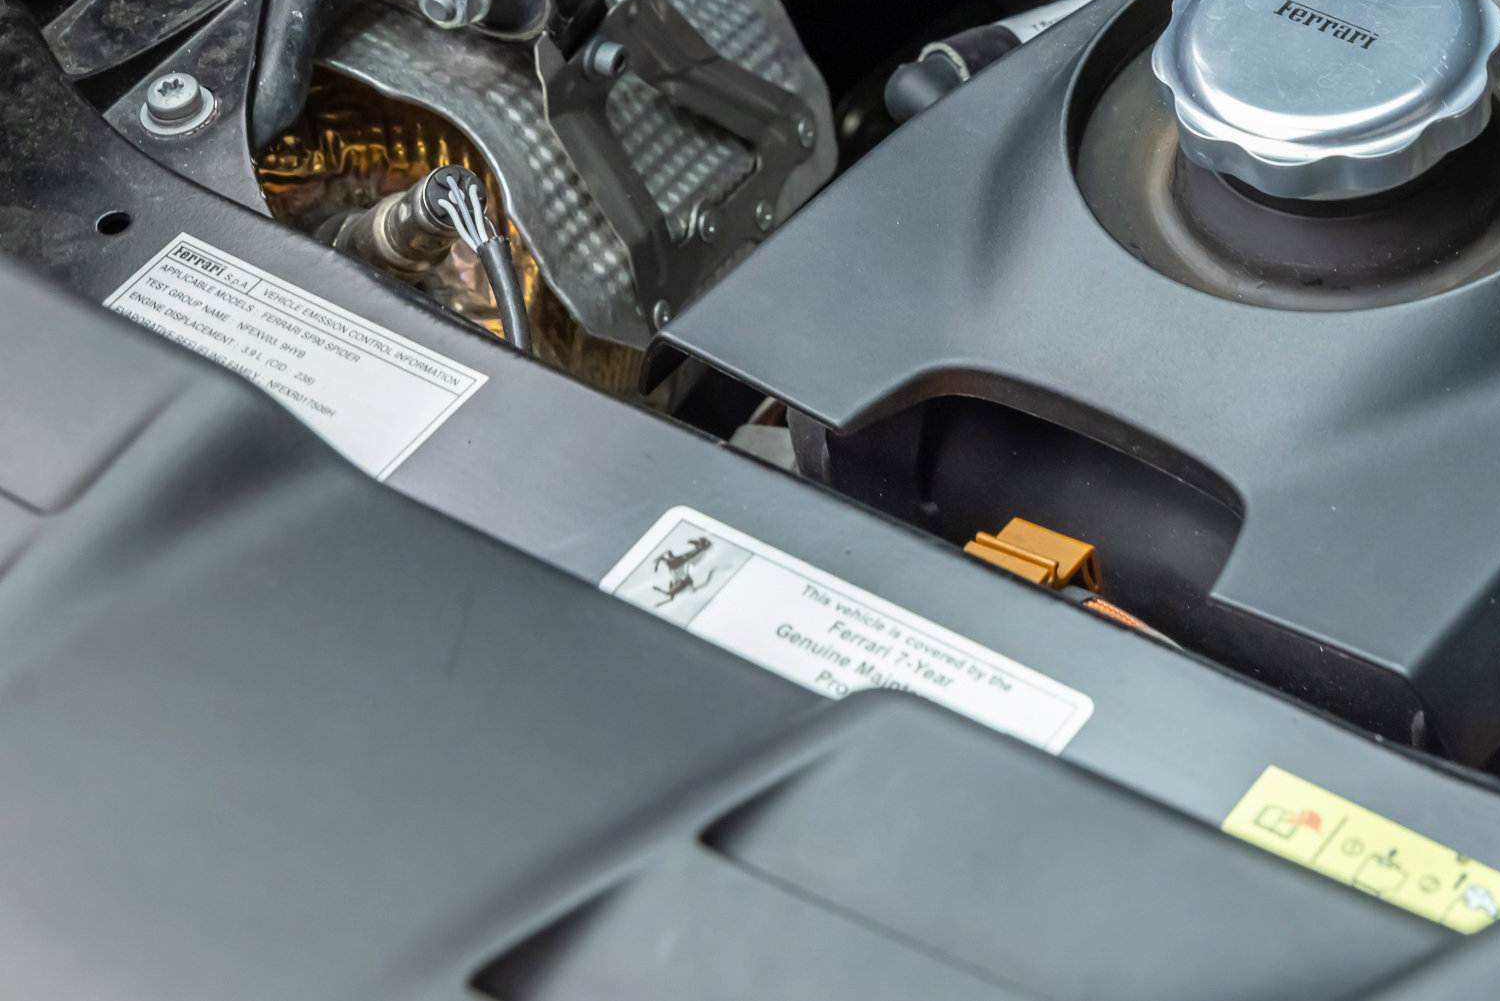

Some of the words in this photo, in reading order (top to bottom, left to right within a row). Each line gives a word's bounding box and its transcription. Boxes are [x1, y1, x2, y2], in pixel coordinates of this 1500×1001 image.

[172, 245, 228, 276] Ferrari
[128, 290, 165, 312] ENGINE
[164, 307, 236, 346] DISPLACEMENT
[145, 277, 168, 292] TEST
[168, 288, 203, 308] GROUP
[161, 264, 216, 294] APPLICABLE
[261, 311, 300, 335] FERRARI
[301, 331, 325, 347] SF90
[324, 342, 361, 364] SPIDER
[263, 288, 303, 310] VEHICLE
[302, 308, 348, 334] EMISSION
[348, 330, 392, 355] CONTROL
[394, 350, 460, 387] INFORMATION
[775, 623, 852, 668] Genuine
[801, 584, 832, 606] This
[835, 600, 886, 632] vehicle
[888, 626, 901, 639] is
[904, 636, 967, 670] covered
[967, 663, 987, 681] by
[988, 674, 1012, 692] the
[827, 619, 893, 658] Ferrari
[894, 650, 955, 688] 7-Year
